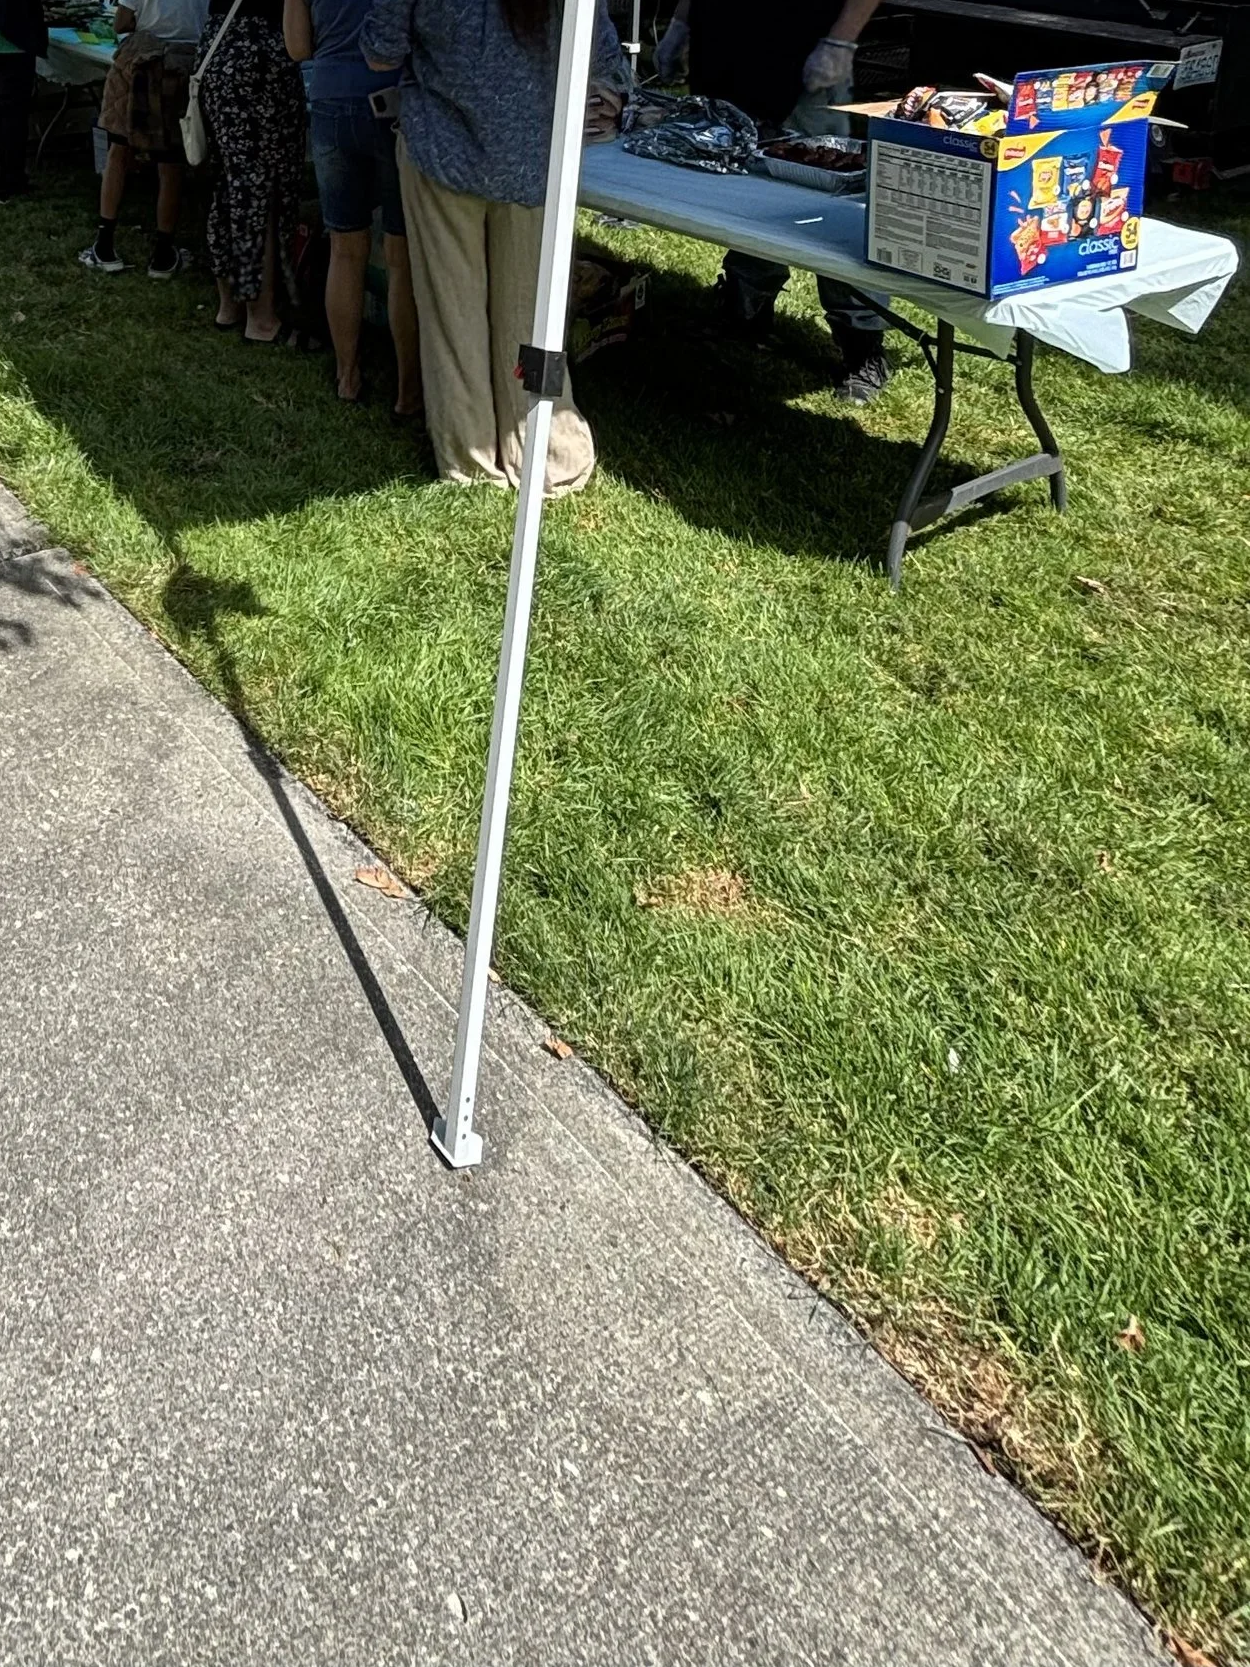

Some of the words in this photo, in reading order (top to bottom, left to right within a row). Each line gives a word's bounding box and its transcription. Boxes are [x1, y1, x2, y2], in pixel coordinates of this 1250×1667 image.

[942, 132, 978, 150] classic
[1125, 221, 1139, 239] 54
[1079, 235, 1120, 257] classic
